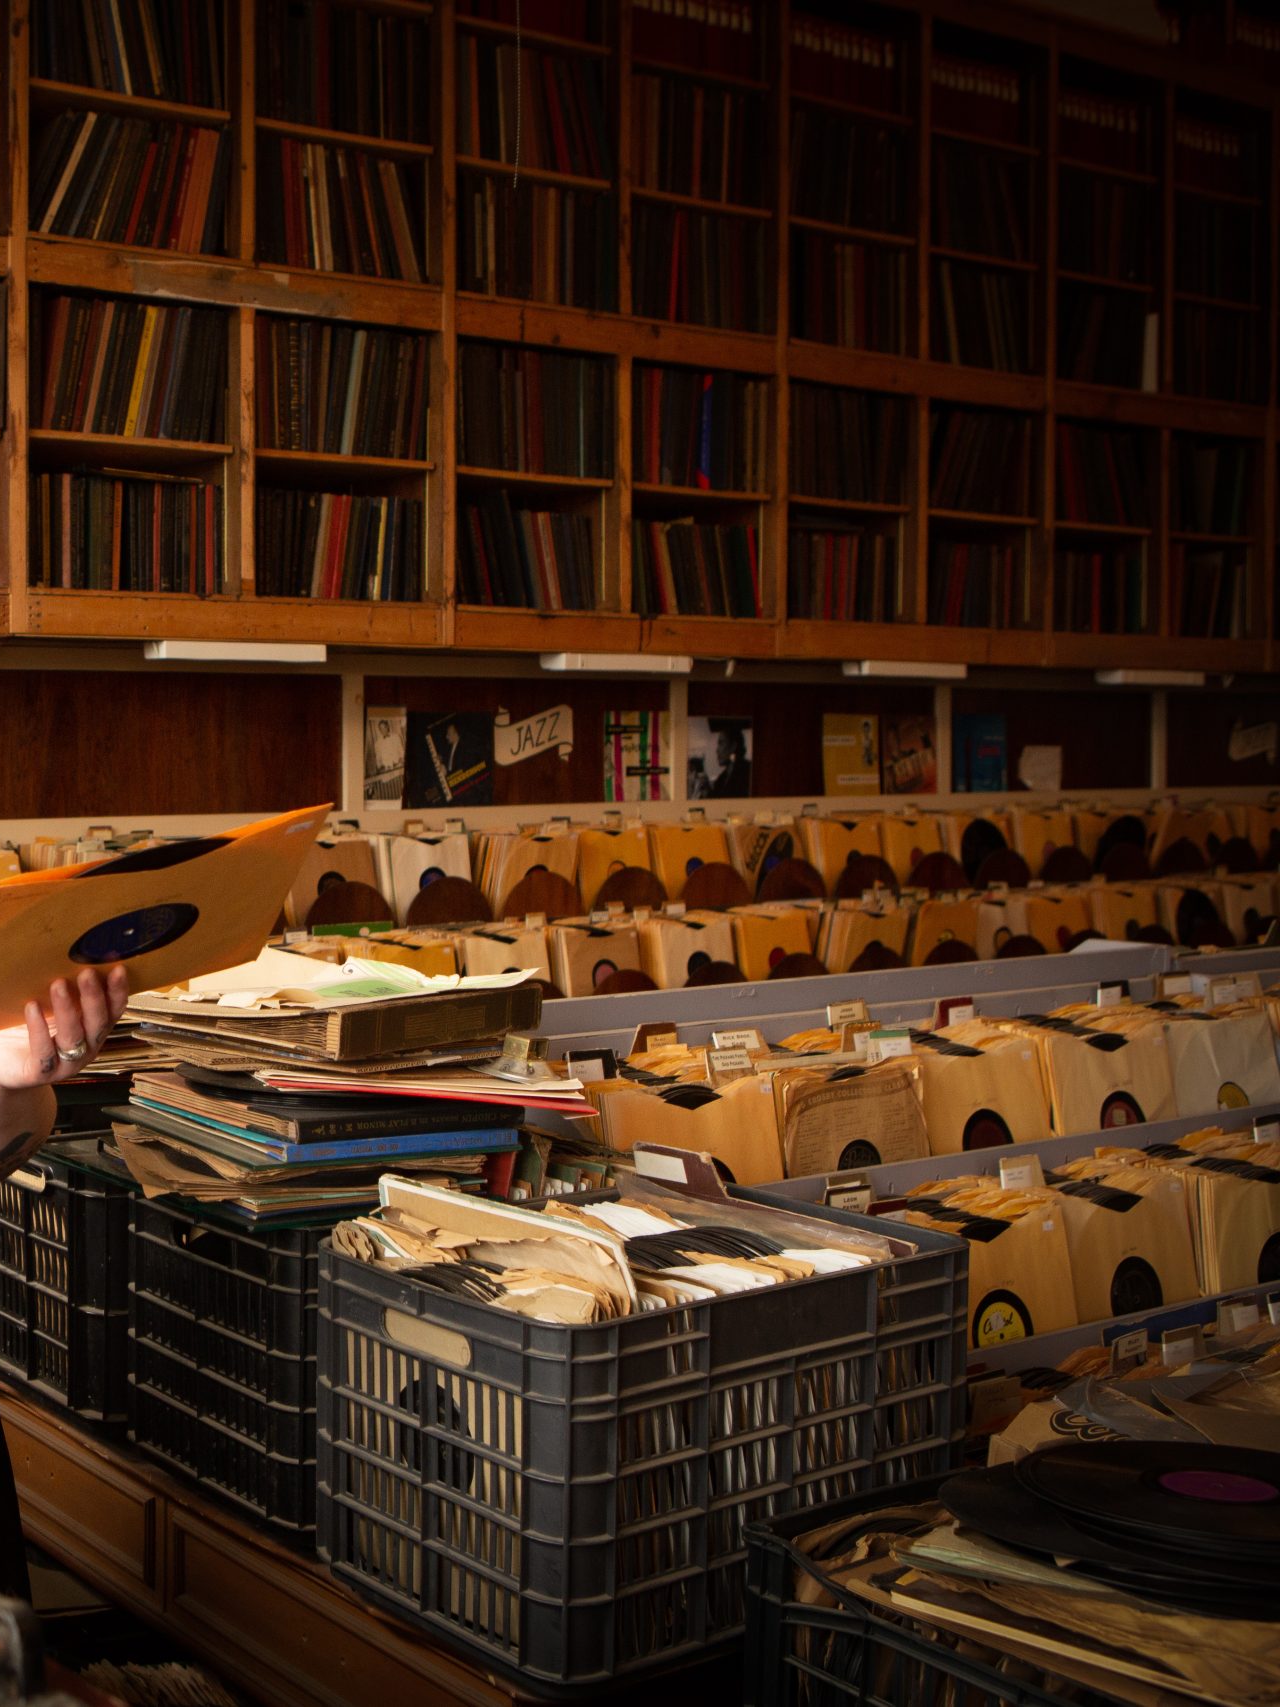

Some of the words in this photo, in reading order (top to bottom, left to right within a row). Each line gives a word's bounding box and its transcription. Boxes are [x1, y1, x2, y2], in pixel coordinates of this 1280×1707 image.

[511, 711, 562, 756] JAZZ
[808, 1092, 835, 1106] CROSBY
[462, 1112, 497, 1123] CHOPIN
[357, 1120, 386, 1130] MINOR
